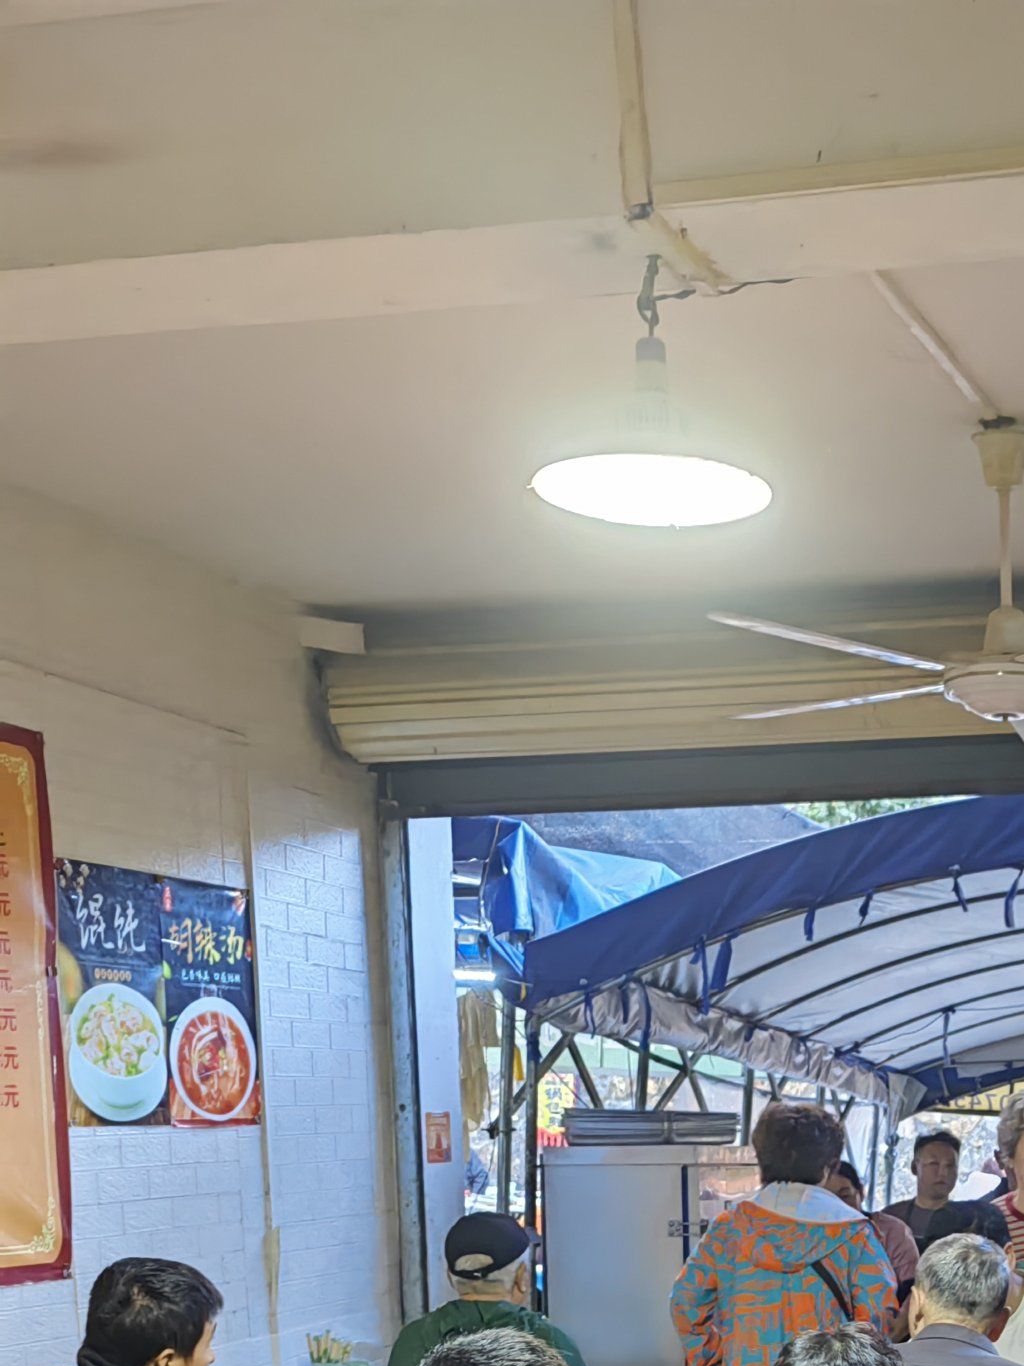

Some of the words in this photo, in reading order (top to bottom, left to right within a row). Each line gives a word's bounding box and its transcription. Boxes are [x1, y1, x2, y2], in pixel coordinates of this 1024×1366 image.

[76, 893, 146, 953] 馄饨
[168, 917, 243, 965] 胡辣汤
